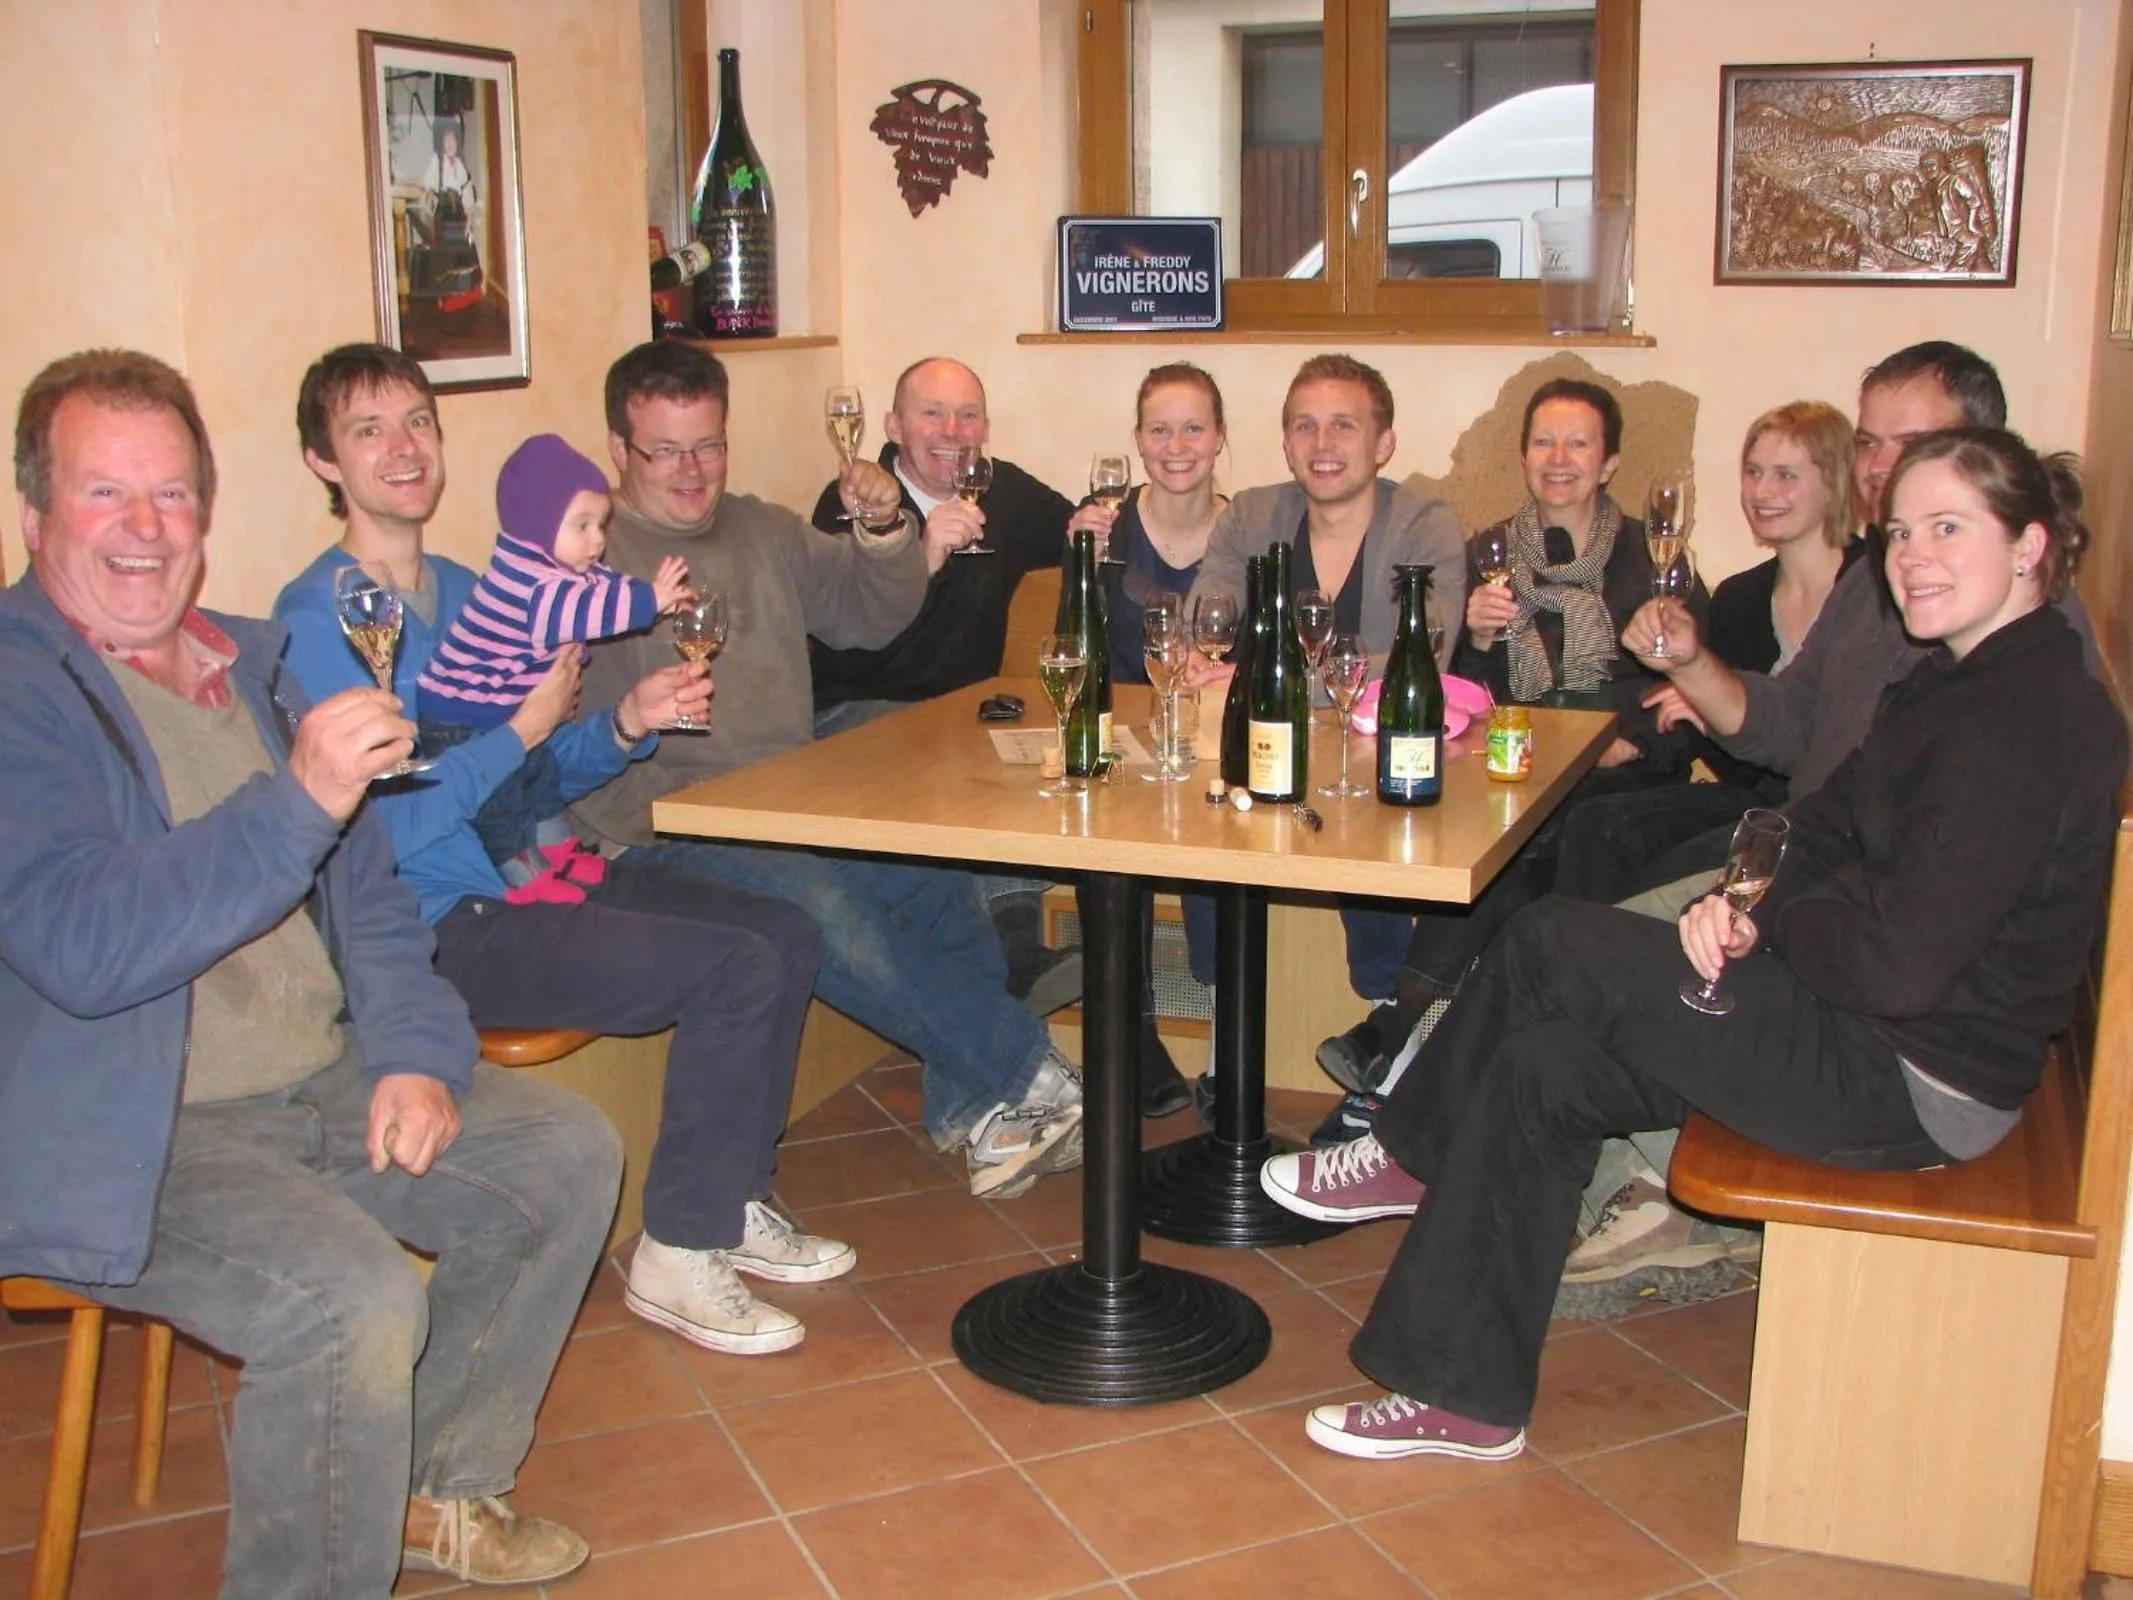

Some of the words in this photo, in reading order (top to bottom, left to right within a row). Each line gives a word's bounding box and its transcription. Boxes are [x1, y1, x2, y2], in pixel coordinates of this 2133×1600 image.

[1134, 260, 1140, 269] &
[1143, 255, 1191, 269] FREDDY
[1076, 271, 1210, 295] VIGNERONS
[1131, 299, 1157, 313] GÎTE
